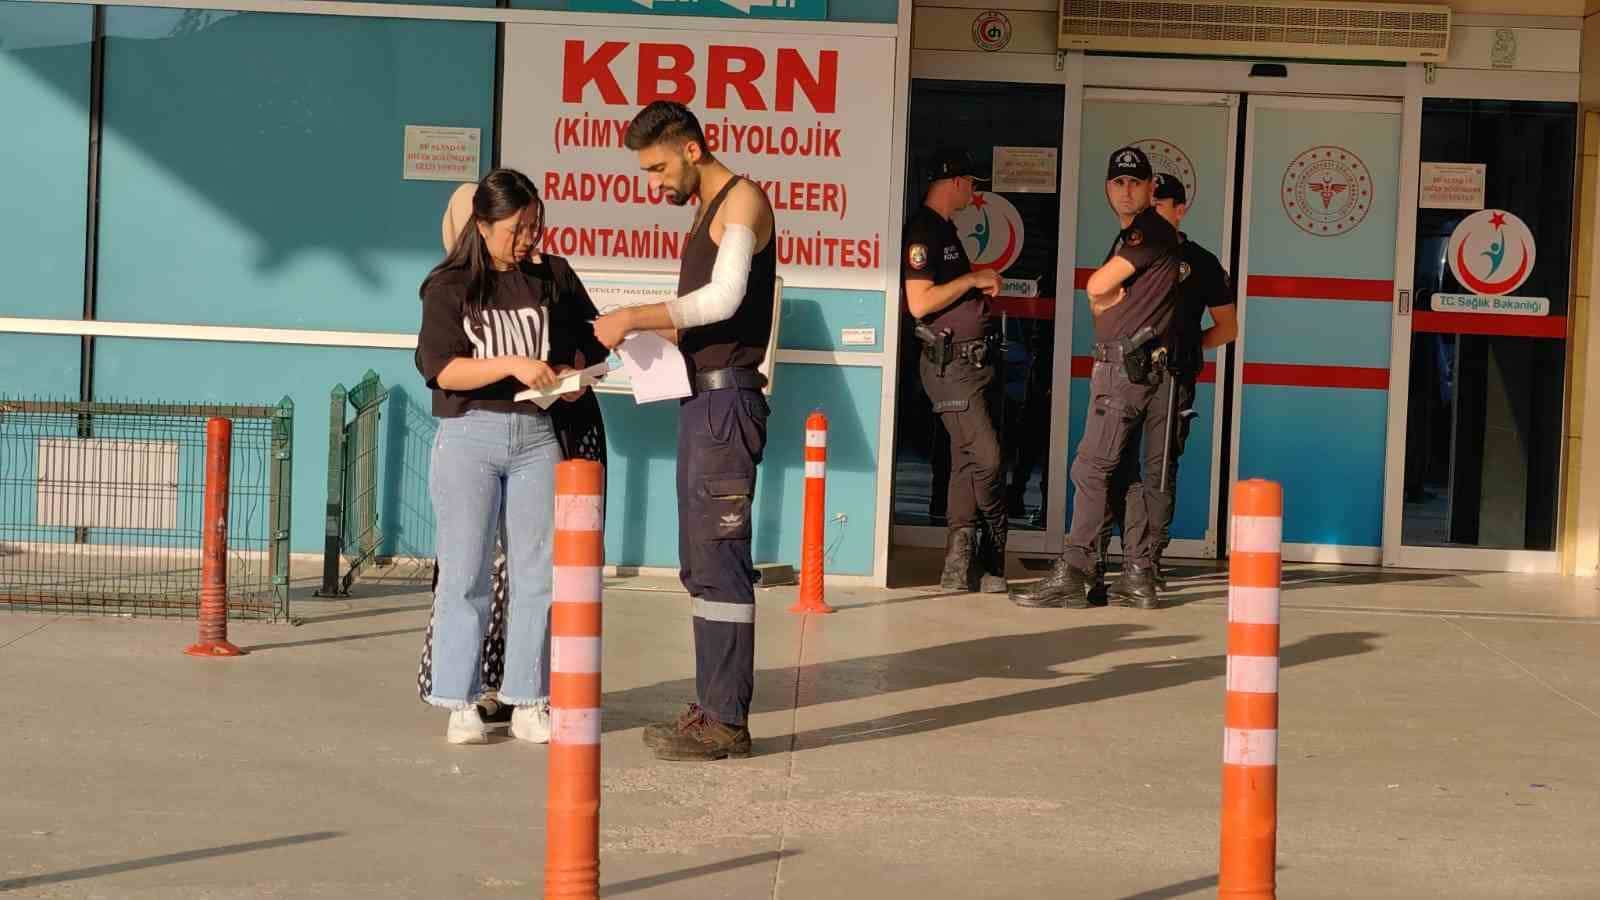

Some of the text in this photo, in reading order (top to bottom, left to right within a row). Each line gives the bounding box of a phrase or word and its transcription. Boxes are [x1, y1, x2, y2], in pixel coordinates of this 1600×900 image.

[562, 40, 838, 113] KBRN
[555, 112, 841, 157] (KİMY BİYOLOJİK
[777, 229, 880, 268] ÜNİTESİ
[463, 306, 551, 361] SUND
